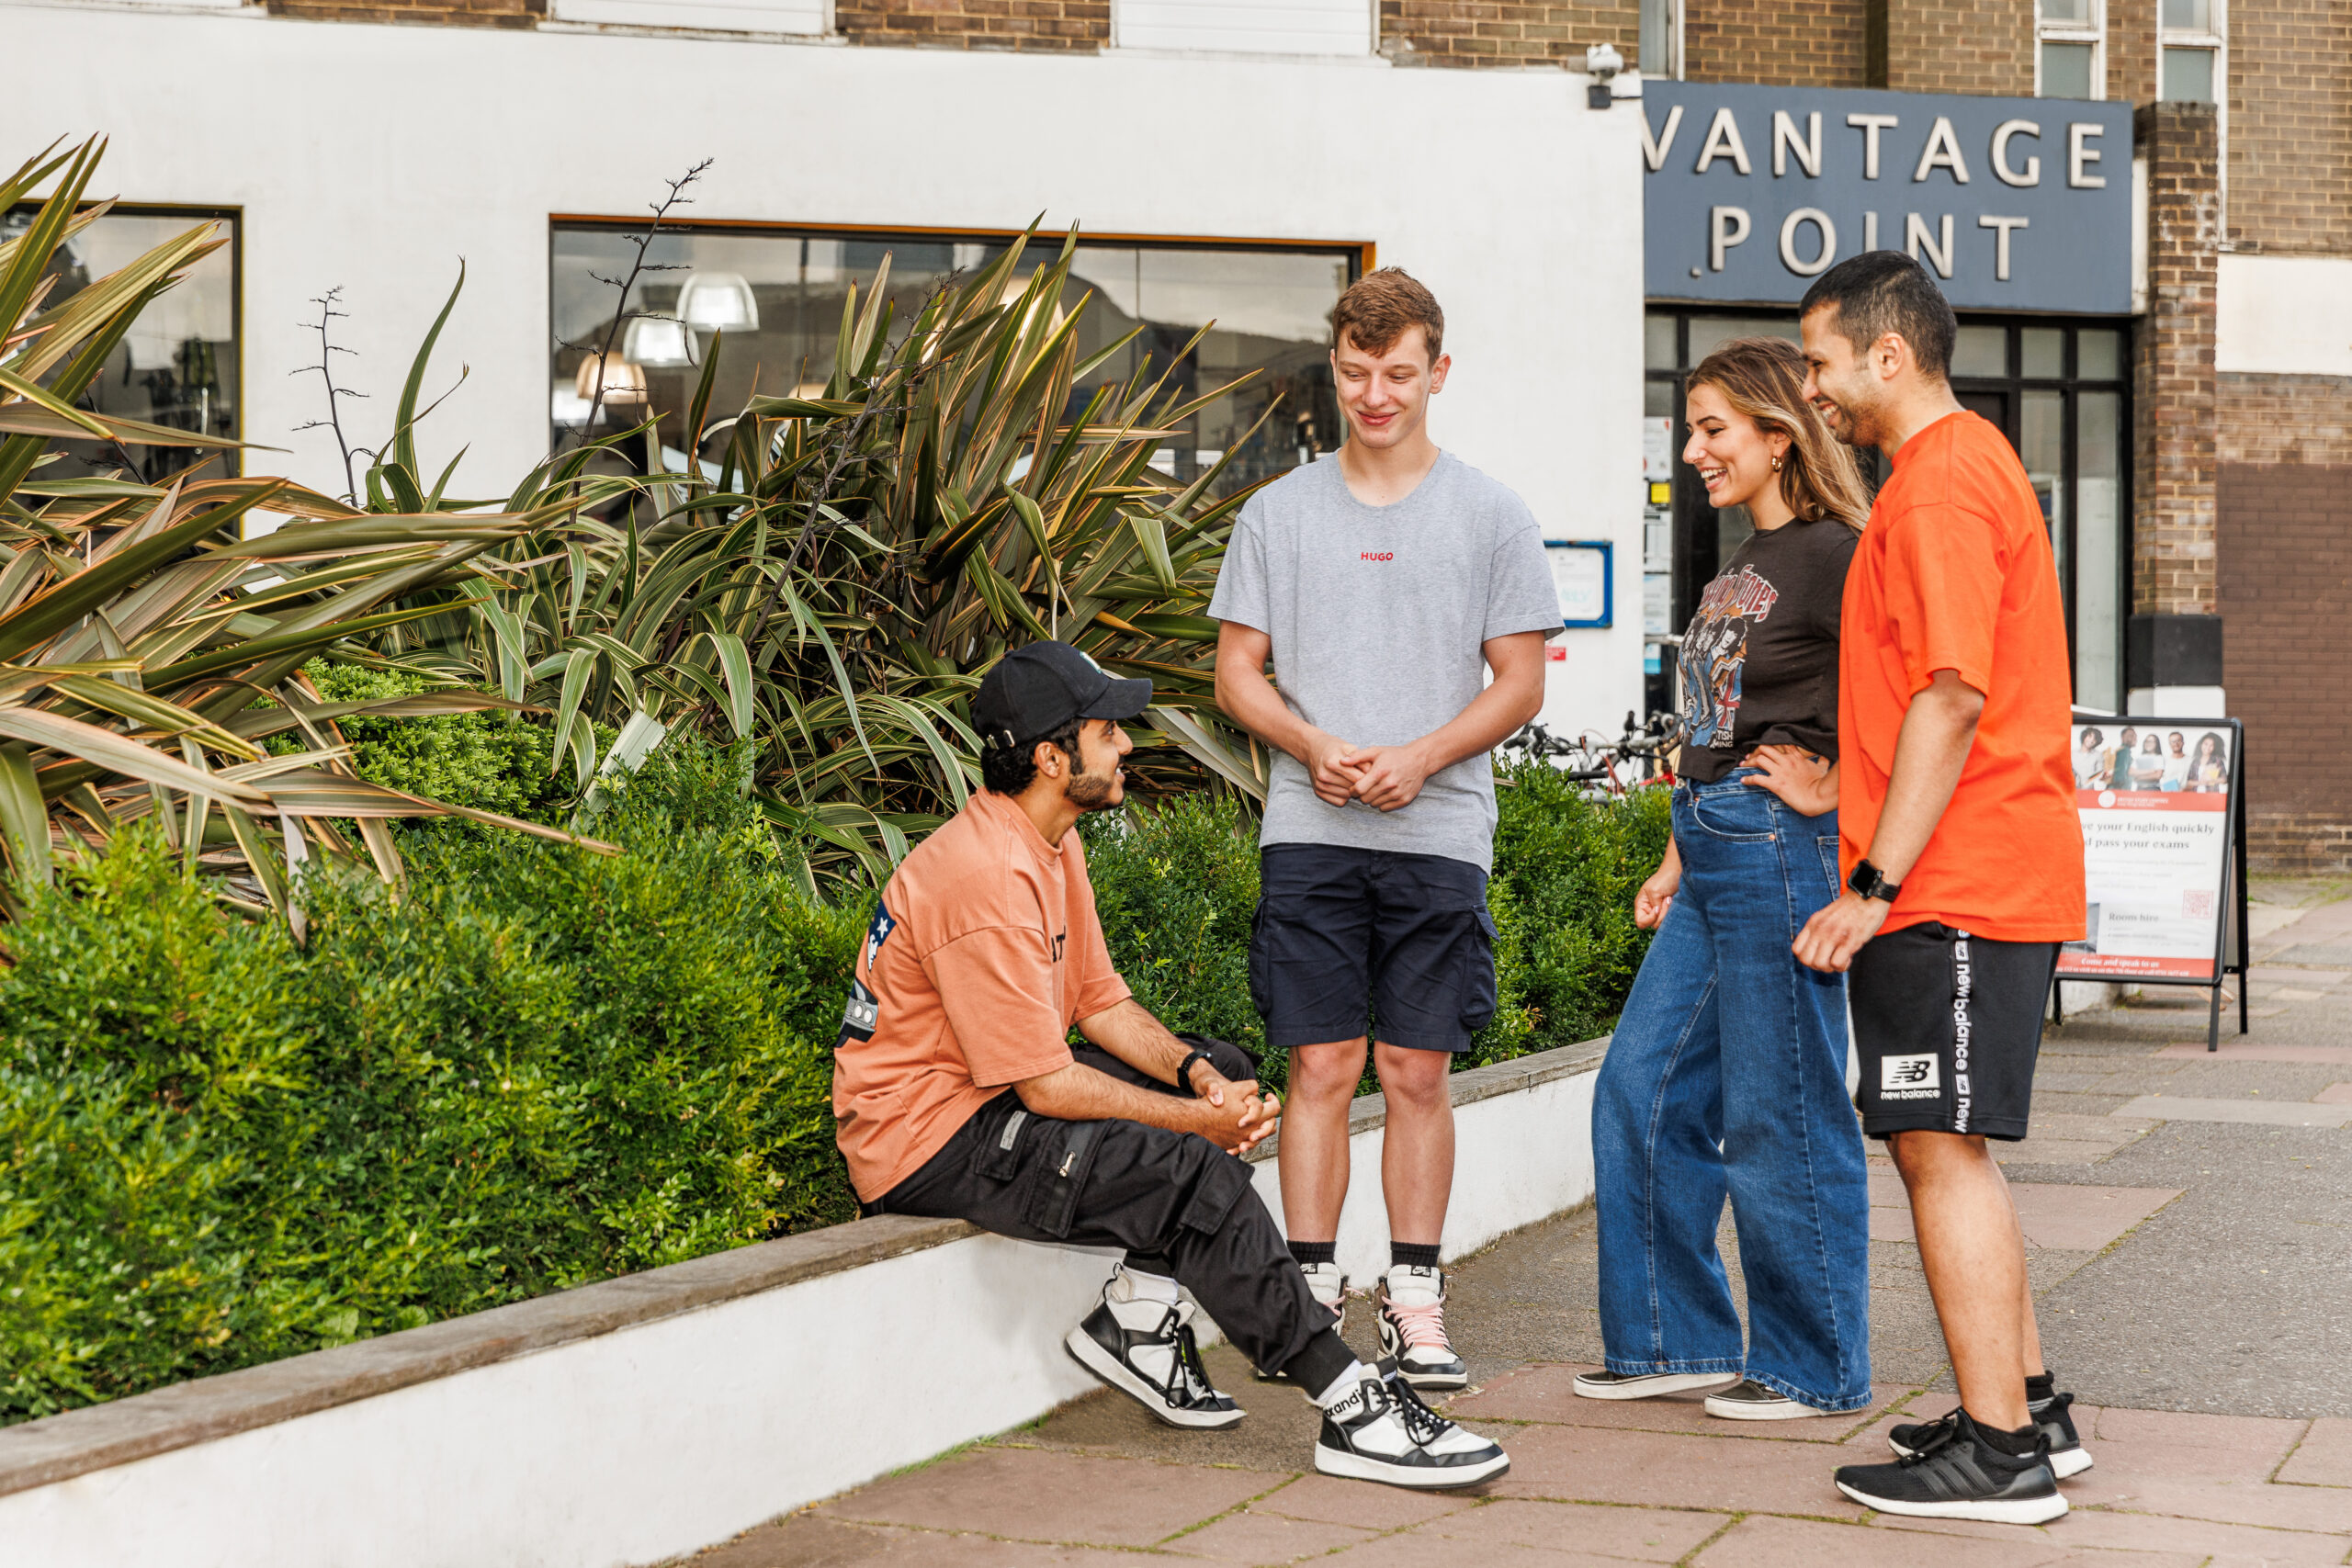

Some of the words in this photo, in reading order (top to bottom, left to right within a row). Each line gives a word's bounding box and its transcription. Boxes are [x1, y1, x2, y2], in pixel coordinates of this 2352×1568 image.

[1642, 105, 2107, 188] VANTAGE
[1711, 206, 2030, 280] POINT
[1361, 552, 1394, 561] HUGO
[2097, 823, 2124, 832] your
[2127, 822, 2168, 833] English
[2172, 823, 2214, 835] quickly
[2096, 840, 2120, 849] pass
[2123, 840, 2149, 849] your
[2153, 840, 2190, 849] exams
[2109, 912, 2138, 921] Room
[1956, 964, 1971, 998] new
[1954, 998, 1972, 1071] balance
[1881, 1090, 1900, 1100] new
[1901, 1089, 1940, 1100] balance
[1955, 1098, 1971, 1134] new
